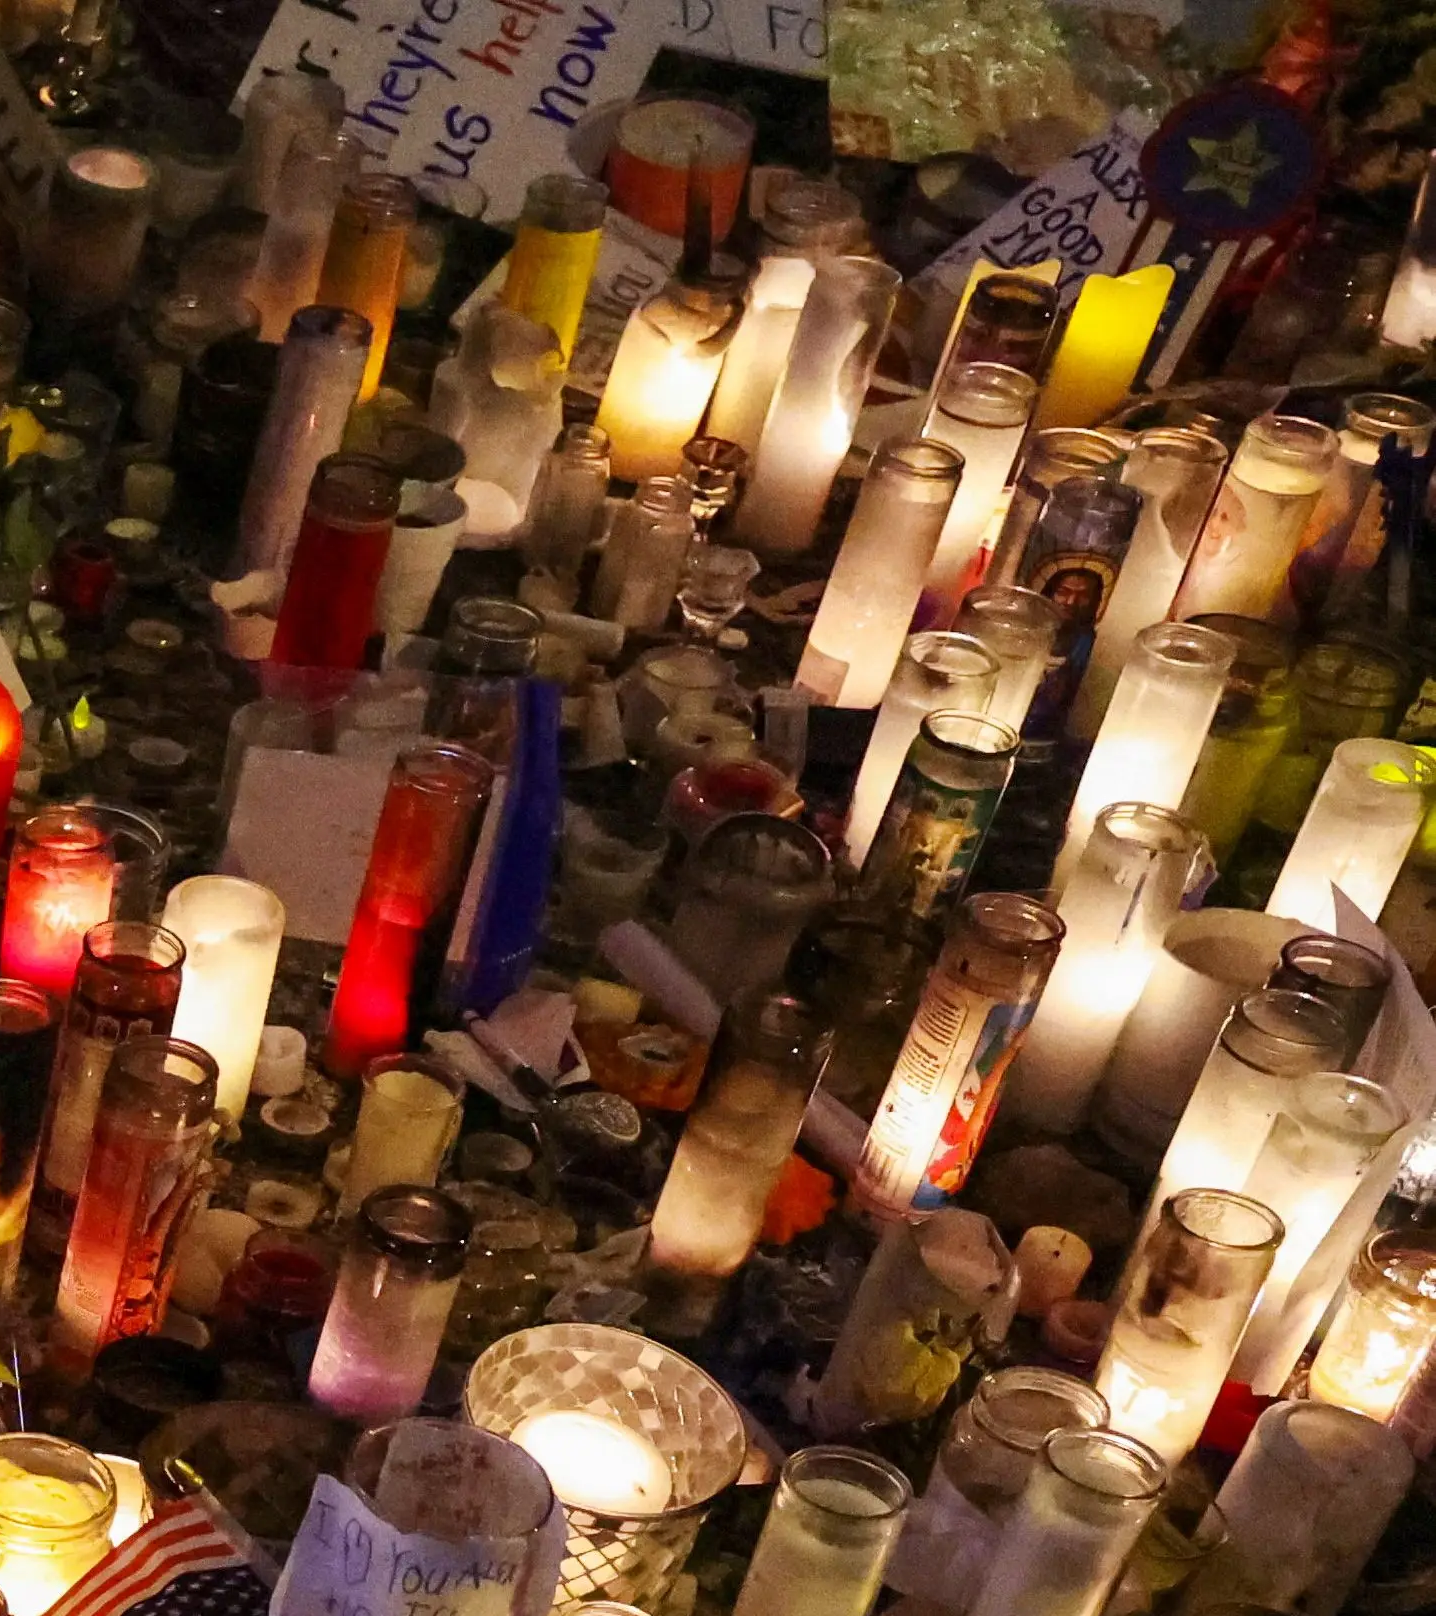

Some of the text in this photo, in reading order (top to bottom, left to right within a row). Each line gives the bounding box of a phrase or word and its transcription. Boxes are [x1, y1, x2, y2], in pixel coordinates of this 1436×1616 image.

[529, 3, 618, 128] now
[424, 104, 492, 181] us
[1071, 142, 1146, 221] ALEX
[1021, 186, 1105, 267] GOOD
[1069, 191, 1099, 220] A
